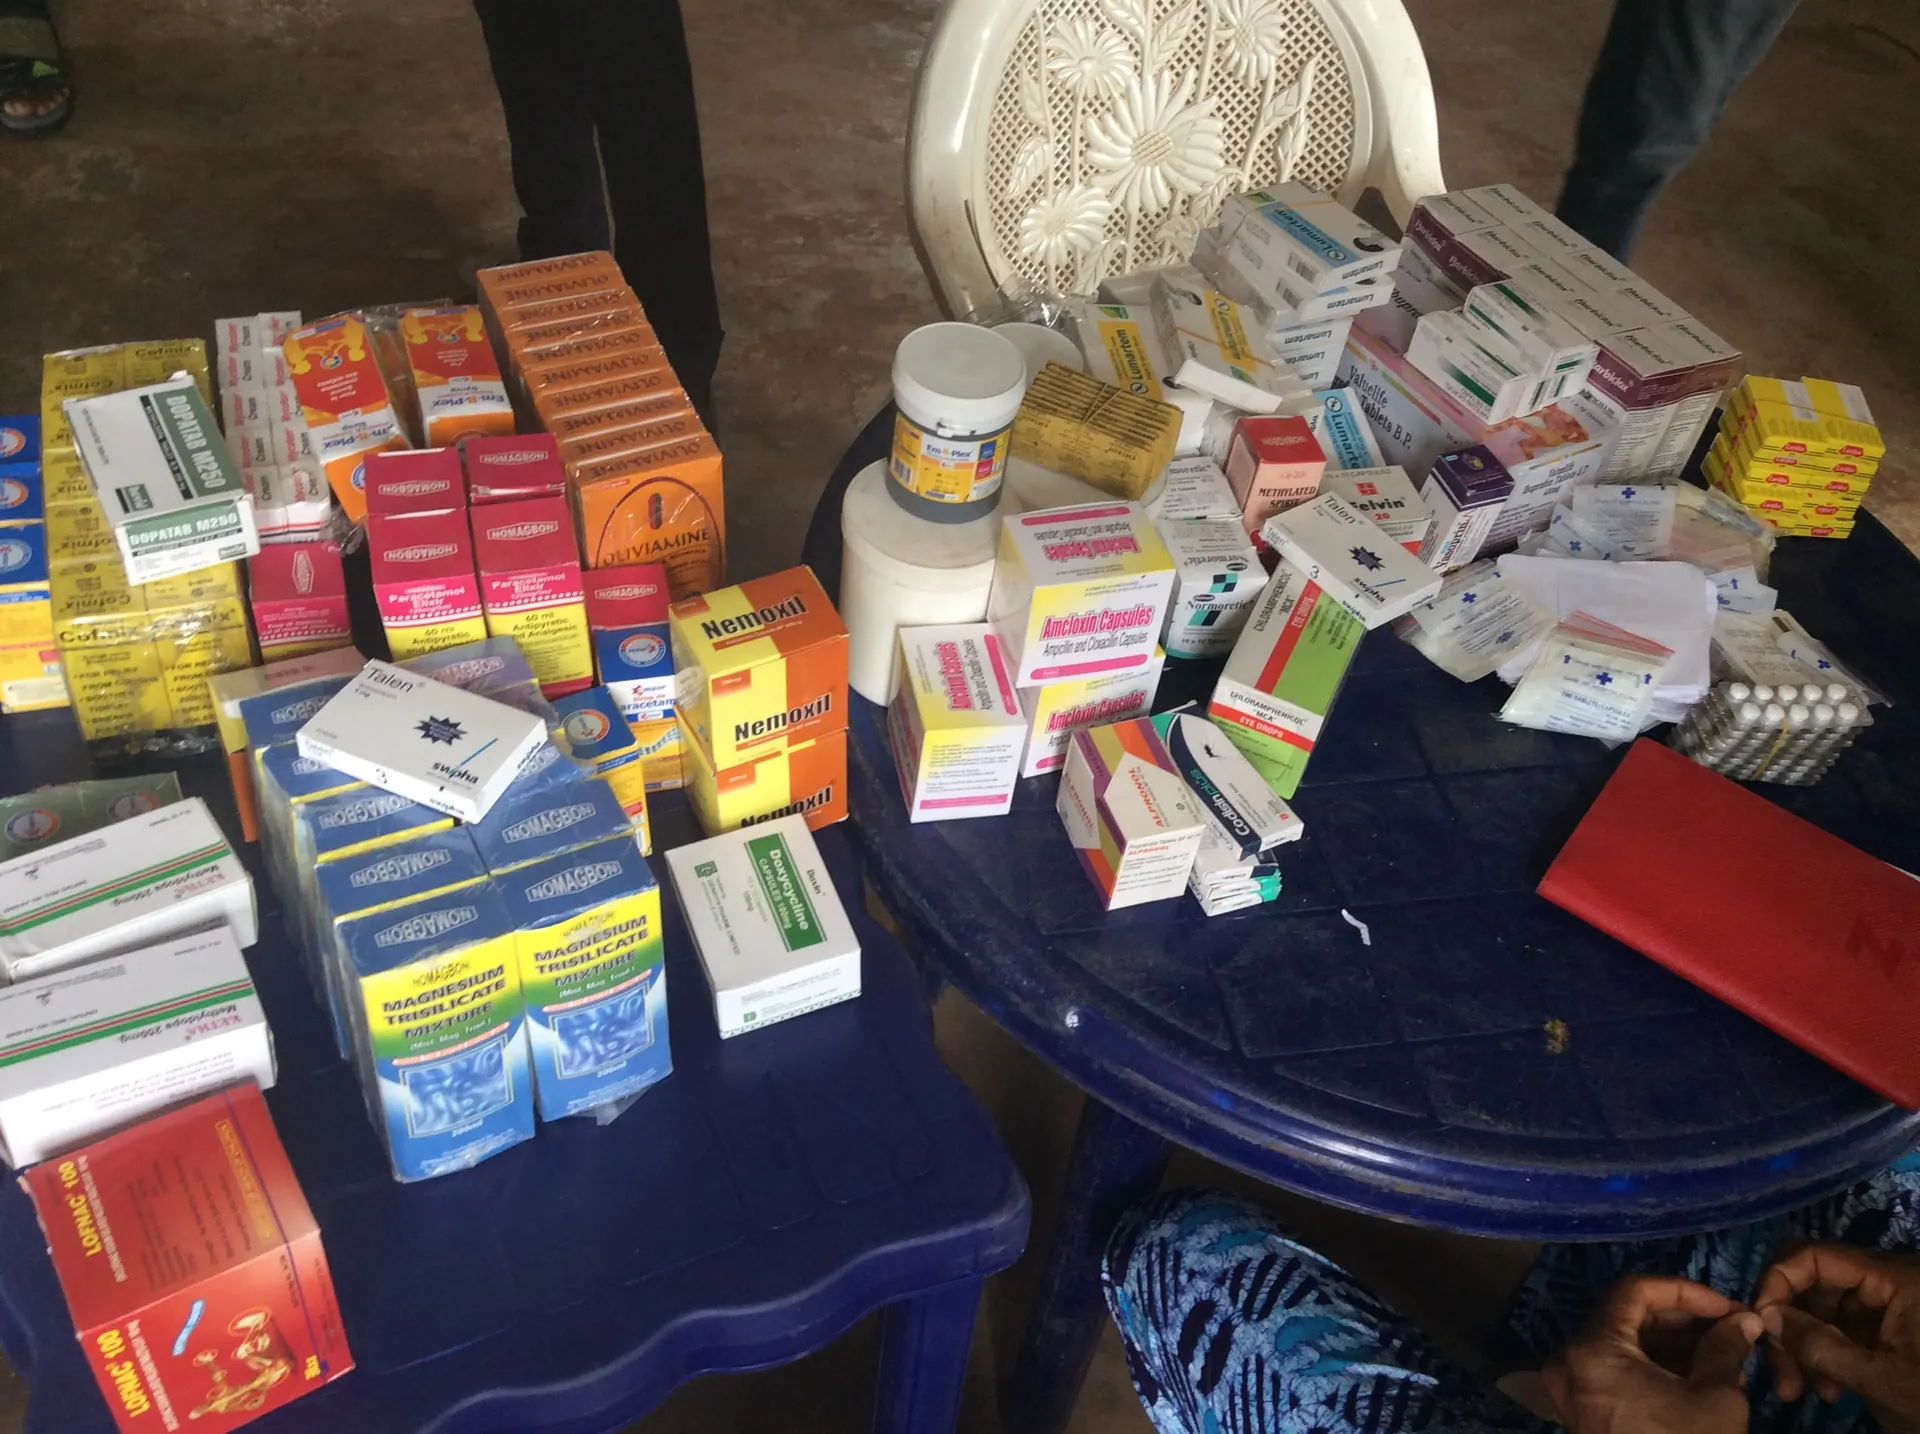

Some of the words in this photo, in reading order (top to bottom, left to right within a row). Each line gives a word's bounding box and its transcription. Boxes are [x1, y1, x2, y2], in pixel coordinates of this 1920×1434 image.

[1273, 208, 1333, 251] Lumartem
[1342, 260, 1383, 280] Lumartem
[506, 275, 608, 300] OLIVIAMINE
[1326, 293, 1374, 309] Lumartem
[536, 330, 640, 362] OLIVIAMINE
[1284, 330, 1332, 345] Lumartem
[544, 353, 649, 385] OLIVIAMINE
[1116, 329, 1143, 386] Lumartem
[1285, 351, 1325, 365] Lumarte
[555, 375, 661, 408] OLIVIAMINE
[1347, 364, 1389, 407] Valuelife
[565, 397, 672, 431] OLIVIAMINE
[1361, 394, 1393, 433] Tablets
[166, 395, 207, 450] DOPATAB
[191, 450, 227, 489] M250
[579, 420, 685, 454] OLIVIAMINE
[1331, 413, 1361, 470] Lumarte
[593, 441, 700, 477] OLIVIAMINE
[1258, 486, 1316, 498] METHYLATED
[1325, 495, 1356, 525] Talon
[1375, 511, 1390, 521] 20
[60, 537, 112, 550] ofmix
[129, 526, 193, 546] DOPATAB
[196, 514, 238, 532] M250
[603, 529, 710, 565] OLIVIAMINE
[389, 588, 465, 603] Paracetamol
[492, 574, 566, 591] Paracetamol
[514, 582, 544, 594] Elixir
[1353, 577, 1387, 604] swipha
[65, 594, 131, 610] Cofmix
[413, 597, 444, 609] Elixir
[1254, 567, 1293, 632] CHLORAMPHENICOL
[424, 626, 438, 637] 60
[512, 617, 570, 632] Antipyretic
[525, 612, 539, 623] 60
[528, 623, 578, 639] Analgesic
[701, 595, 809, 641] Nemoxil
[1040, 611, 1098, 641] Amcloxin
[1099, 603, 1155, 631] Capsules
[412, 631, 471, 646] Antipyretic
[365, 664, 416, 693] Talon
[621, 696, 677, 711] aracetam
[734, 694, 832, 742] Nemoxil
[1047, 704, 1099, 734] Amcloxin
[1230, 691, 1307, 727] CHLORAMPHENICOL
[1239, 716, 1257, 729] EYE
[1259, 721, 1285, 738] DROPS
[430, 760, 480, 786] swipha
[1128, 767, 1165, 828] ALPRONOL
[503, 804, 595, 843] NOMAGBON
[352, 851, 450, 887] NOMAGBON
[527, 862, 621, 902] NOMAGBON
[759, 858, 780, 902] CAPSULES
[777, 902, 791, 930] 100mg
[769, 849, 809, 931] Doxycycline
[377, 906, 477, 947] NOMAGBON
[534, 915, 647, 962] MAGNESIUM
[536, 929, 649, 975] TRISILICATE
[555, 951, 637, 987] MIXTURE
[383, 964, 505, 1012] MAGNESIUM
[384, 979, 506, 1026] TRISILICATE
[405, 1002, 493, 1038] MIXTURE
[58, 1161, 79, 1189] 100
[96, 1329, 127, 1360] 100
